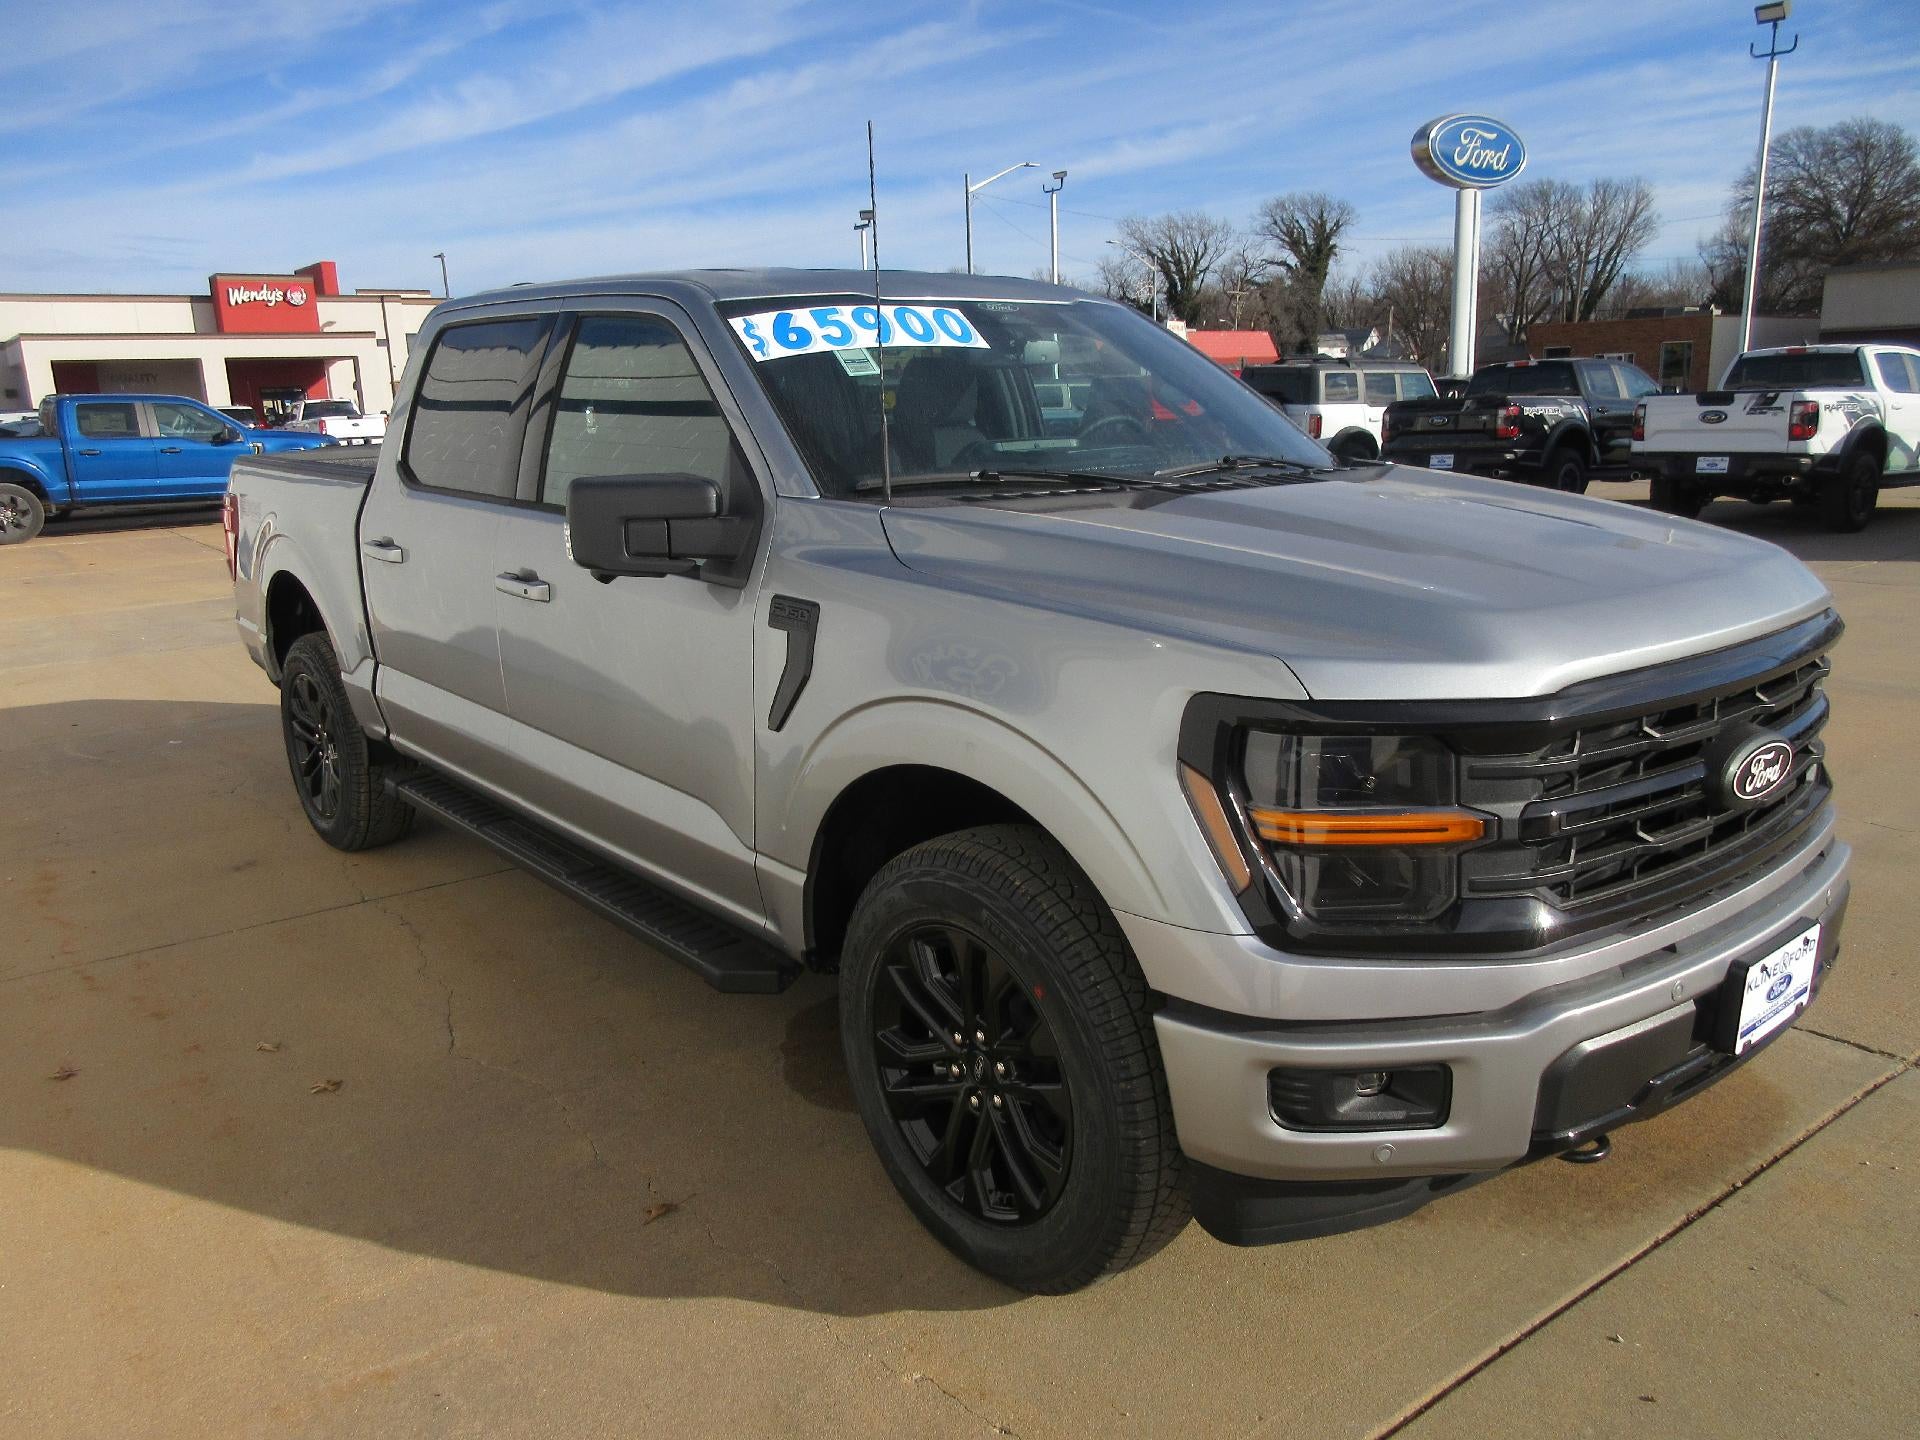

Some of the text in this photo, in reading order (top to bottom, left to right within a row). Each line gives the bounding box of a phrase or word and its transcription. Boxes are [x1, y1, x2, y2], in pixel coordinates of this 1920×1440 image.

[1453, 127, 1510, 171] Ford
[228, 283, 284, 306] Wendy's
[742, 306, 976, 358] $65900
[1745, 751, 1783, 793] Ford
